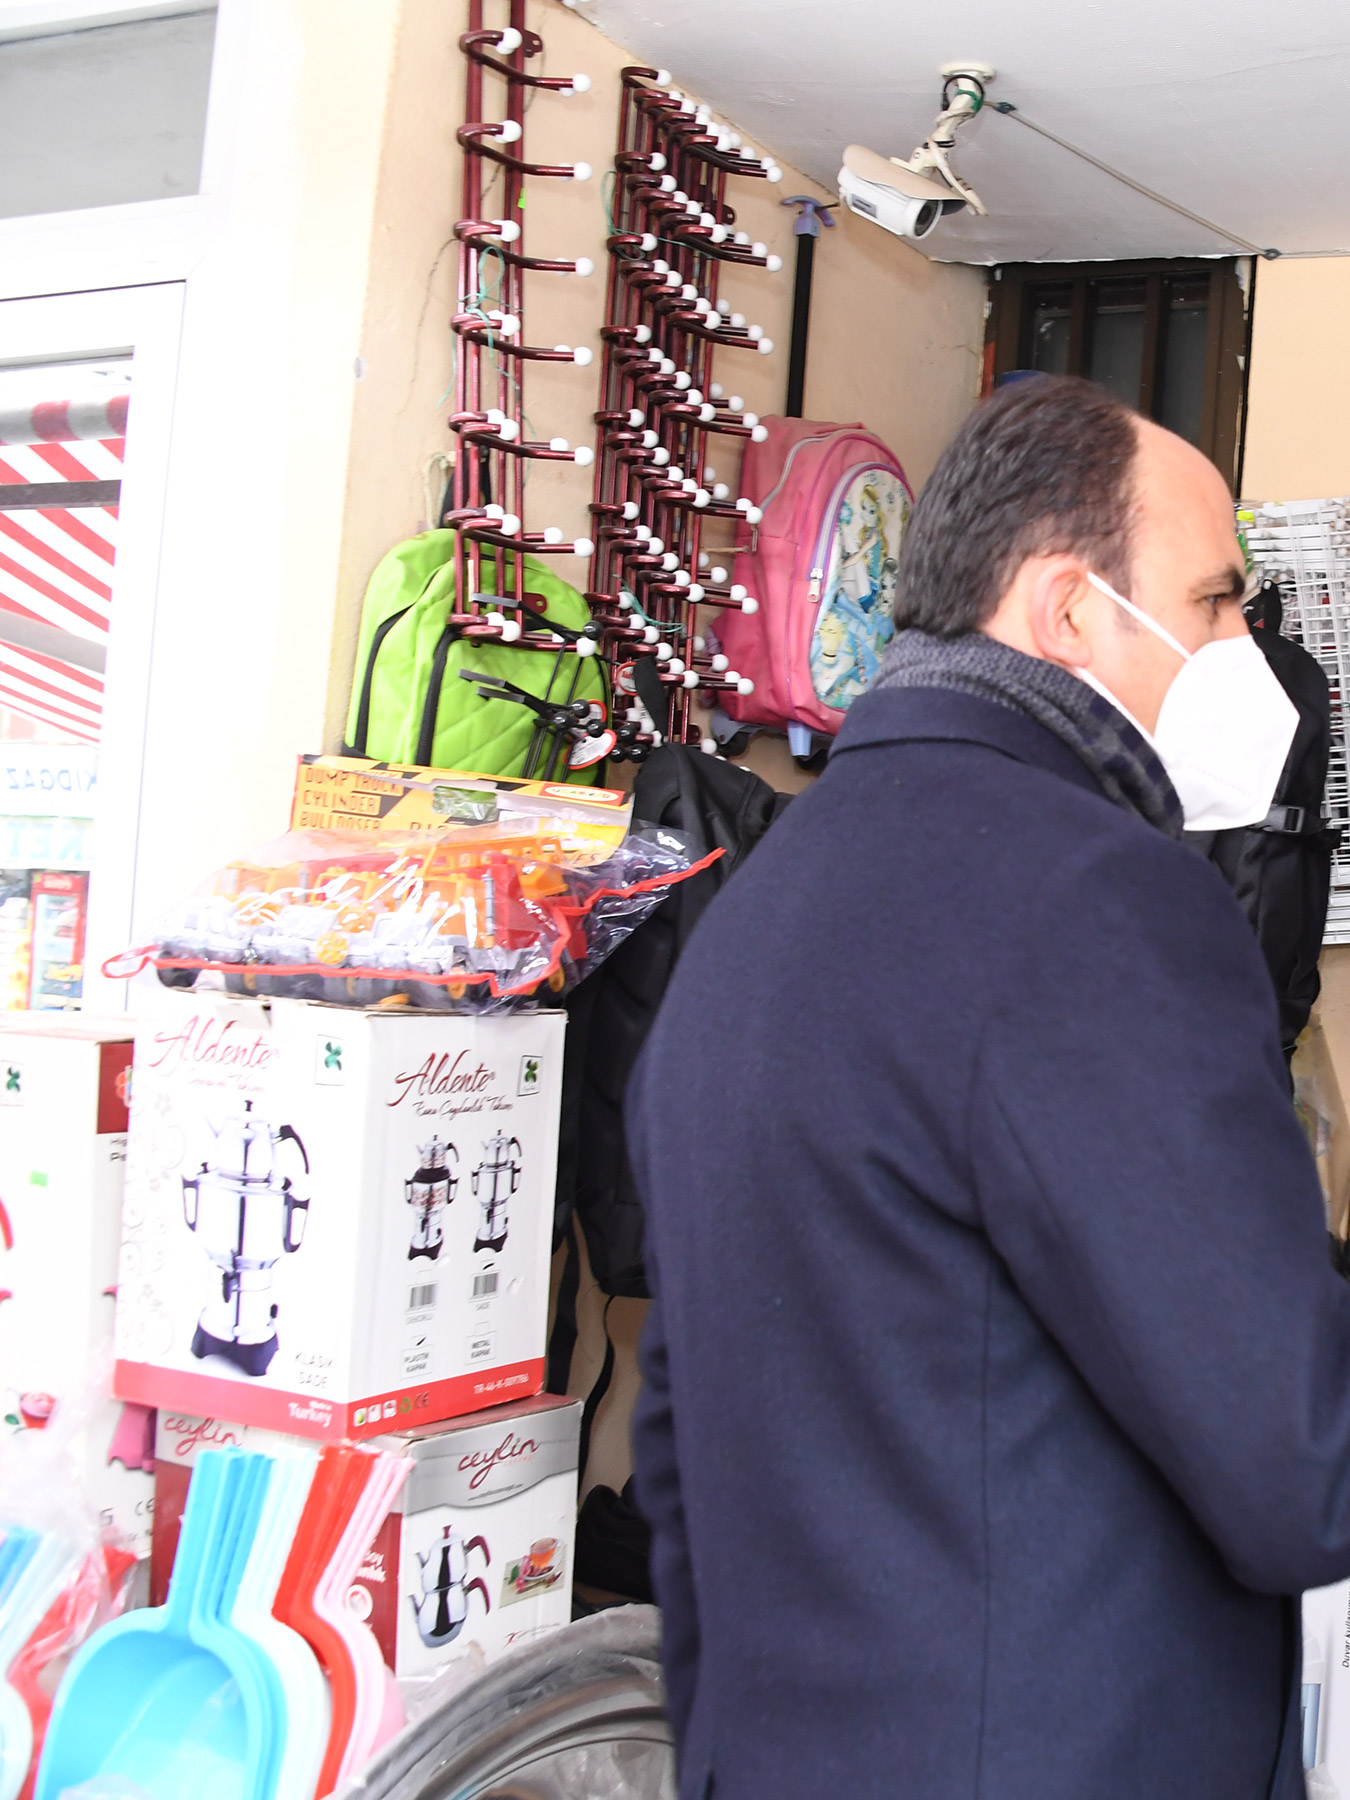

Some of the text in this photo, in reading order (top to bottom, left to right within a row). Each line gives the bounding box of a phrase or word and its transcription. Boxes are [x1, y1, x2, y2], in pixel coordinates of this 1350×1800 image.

[305, 767, 348, 787] DUMP
[302, 790, 377, 811] CYLINDER
[148, 1015, 274, 1069] Aldente
[386, 1049, 490, 1107] Aldente
[289, 1403, 331, 1427] Turkey
[457, 1432, 542, 1490] ceylin
[1342, 1640, 1350, 1669] Duvar
